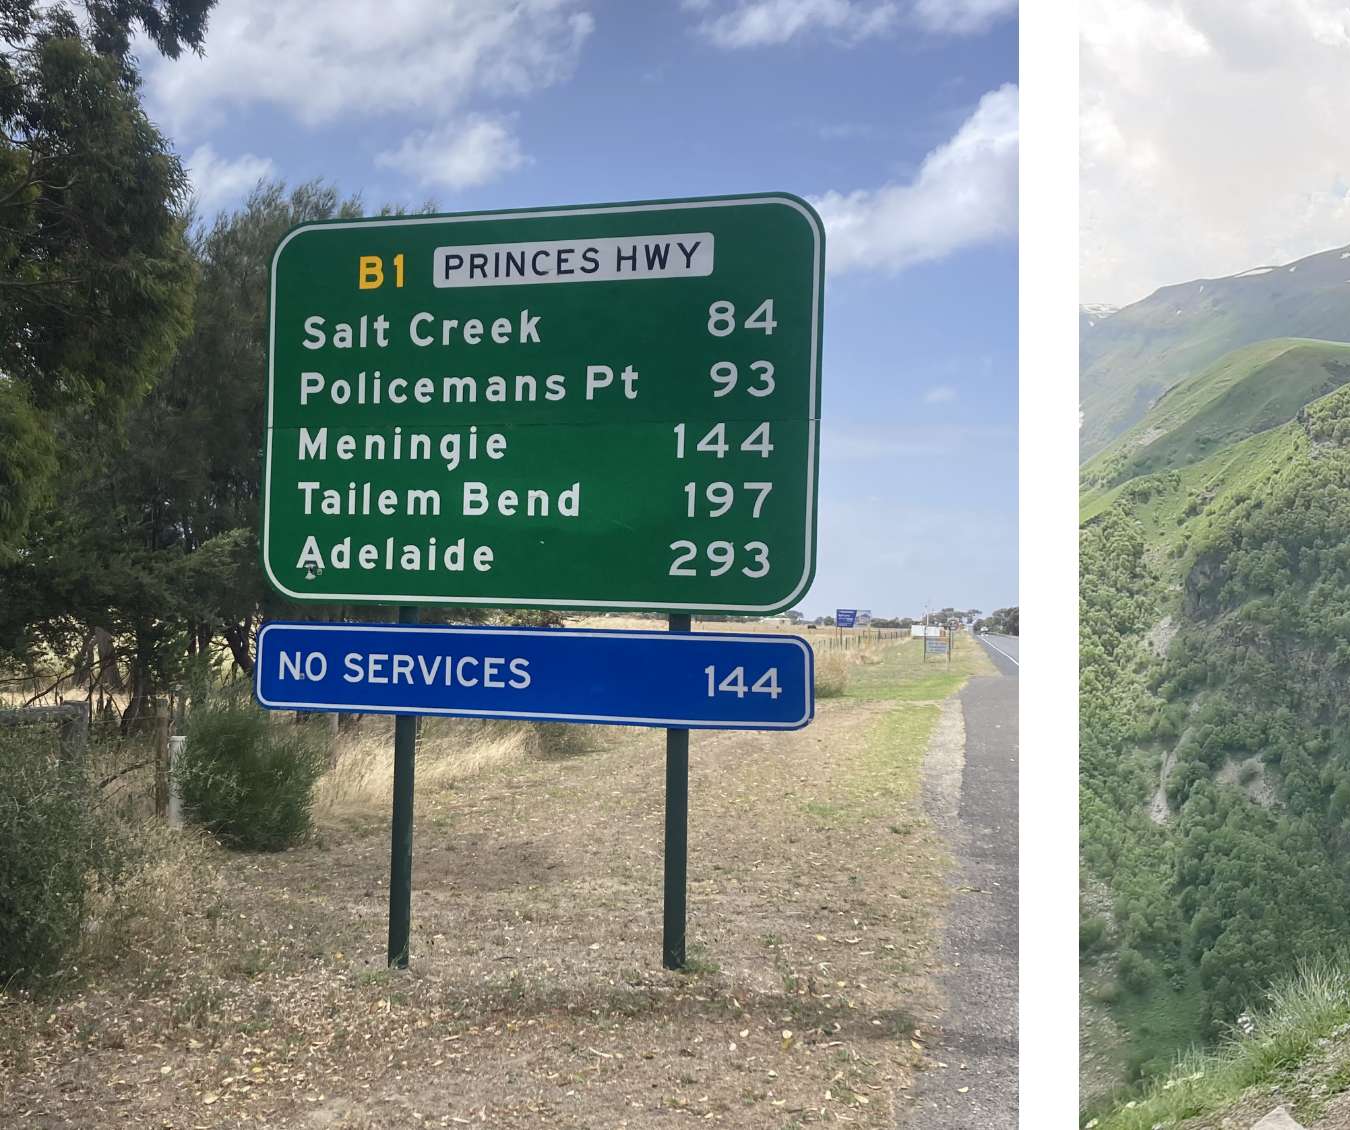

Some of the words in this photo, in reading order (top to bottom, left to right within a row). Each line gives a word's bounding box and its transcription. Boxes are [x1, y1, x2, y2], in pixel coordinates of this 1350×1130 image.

[359, 254, 404, 290] B1
[444, 247, 600, 280] PRINCES
[615, 241, 702, 272] HWY
[302, 315, 390, 350] Salt
[409, 309, 542, 347] Creek
[707, 299, 778, 337] 84
[300, 371, 566, 405] Policemans
[586, 365, 639, 400] Pt
[710, 361, 776, 398] 93
[298, 426, 507, 471] Meningie
[673, 422, 774, 459] 144
[298, 482, 441, 516] Tailem
[462, 482, 580, 517] Bend
[684, 482, 773, 518] 197
[296, 535, 494, 571] Adelaide
[669, 540, 770, 579] 293
[278, 651, 327, 682] NO
[343, 653, 531, 689] SERVICES
[704, 665, 782, 699] 144
